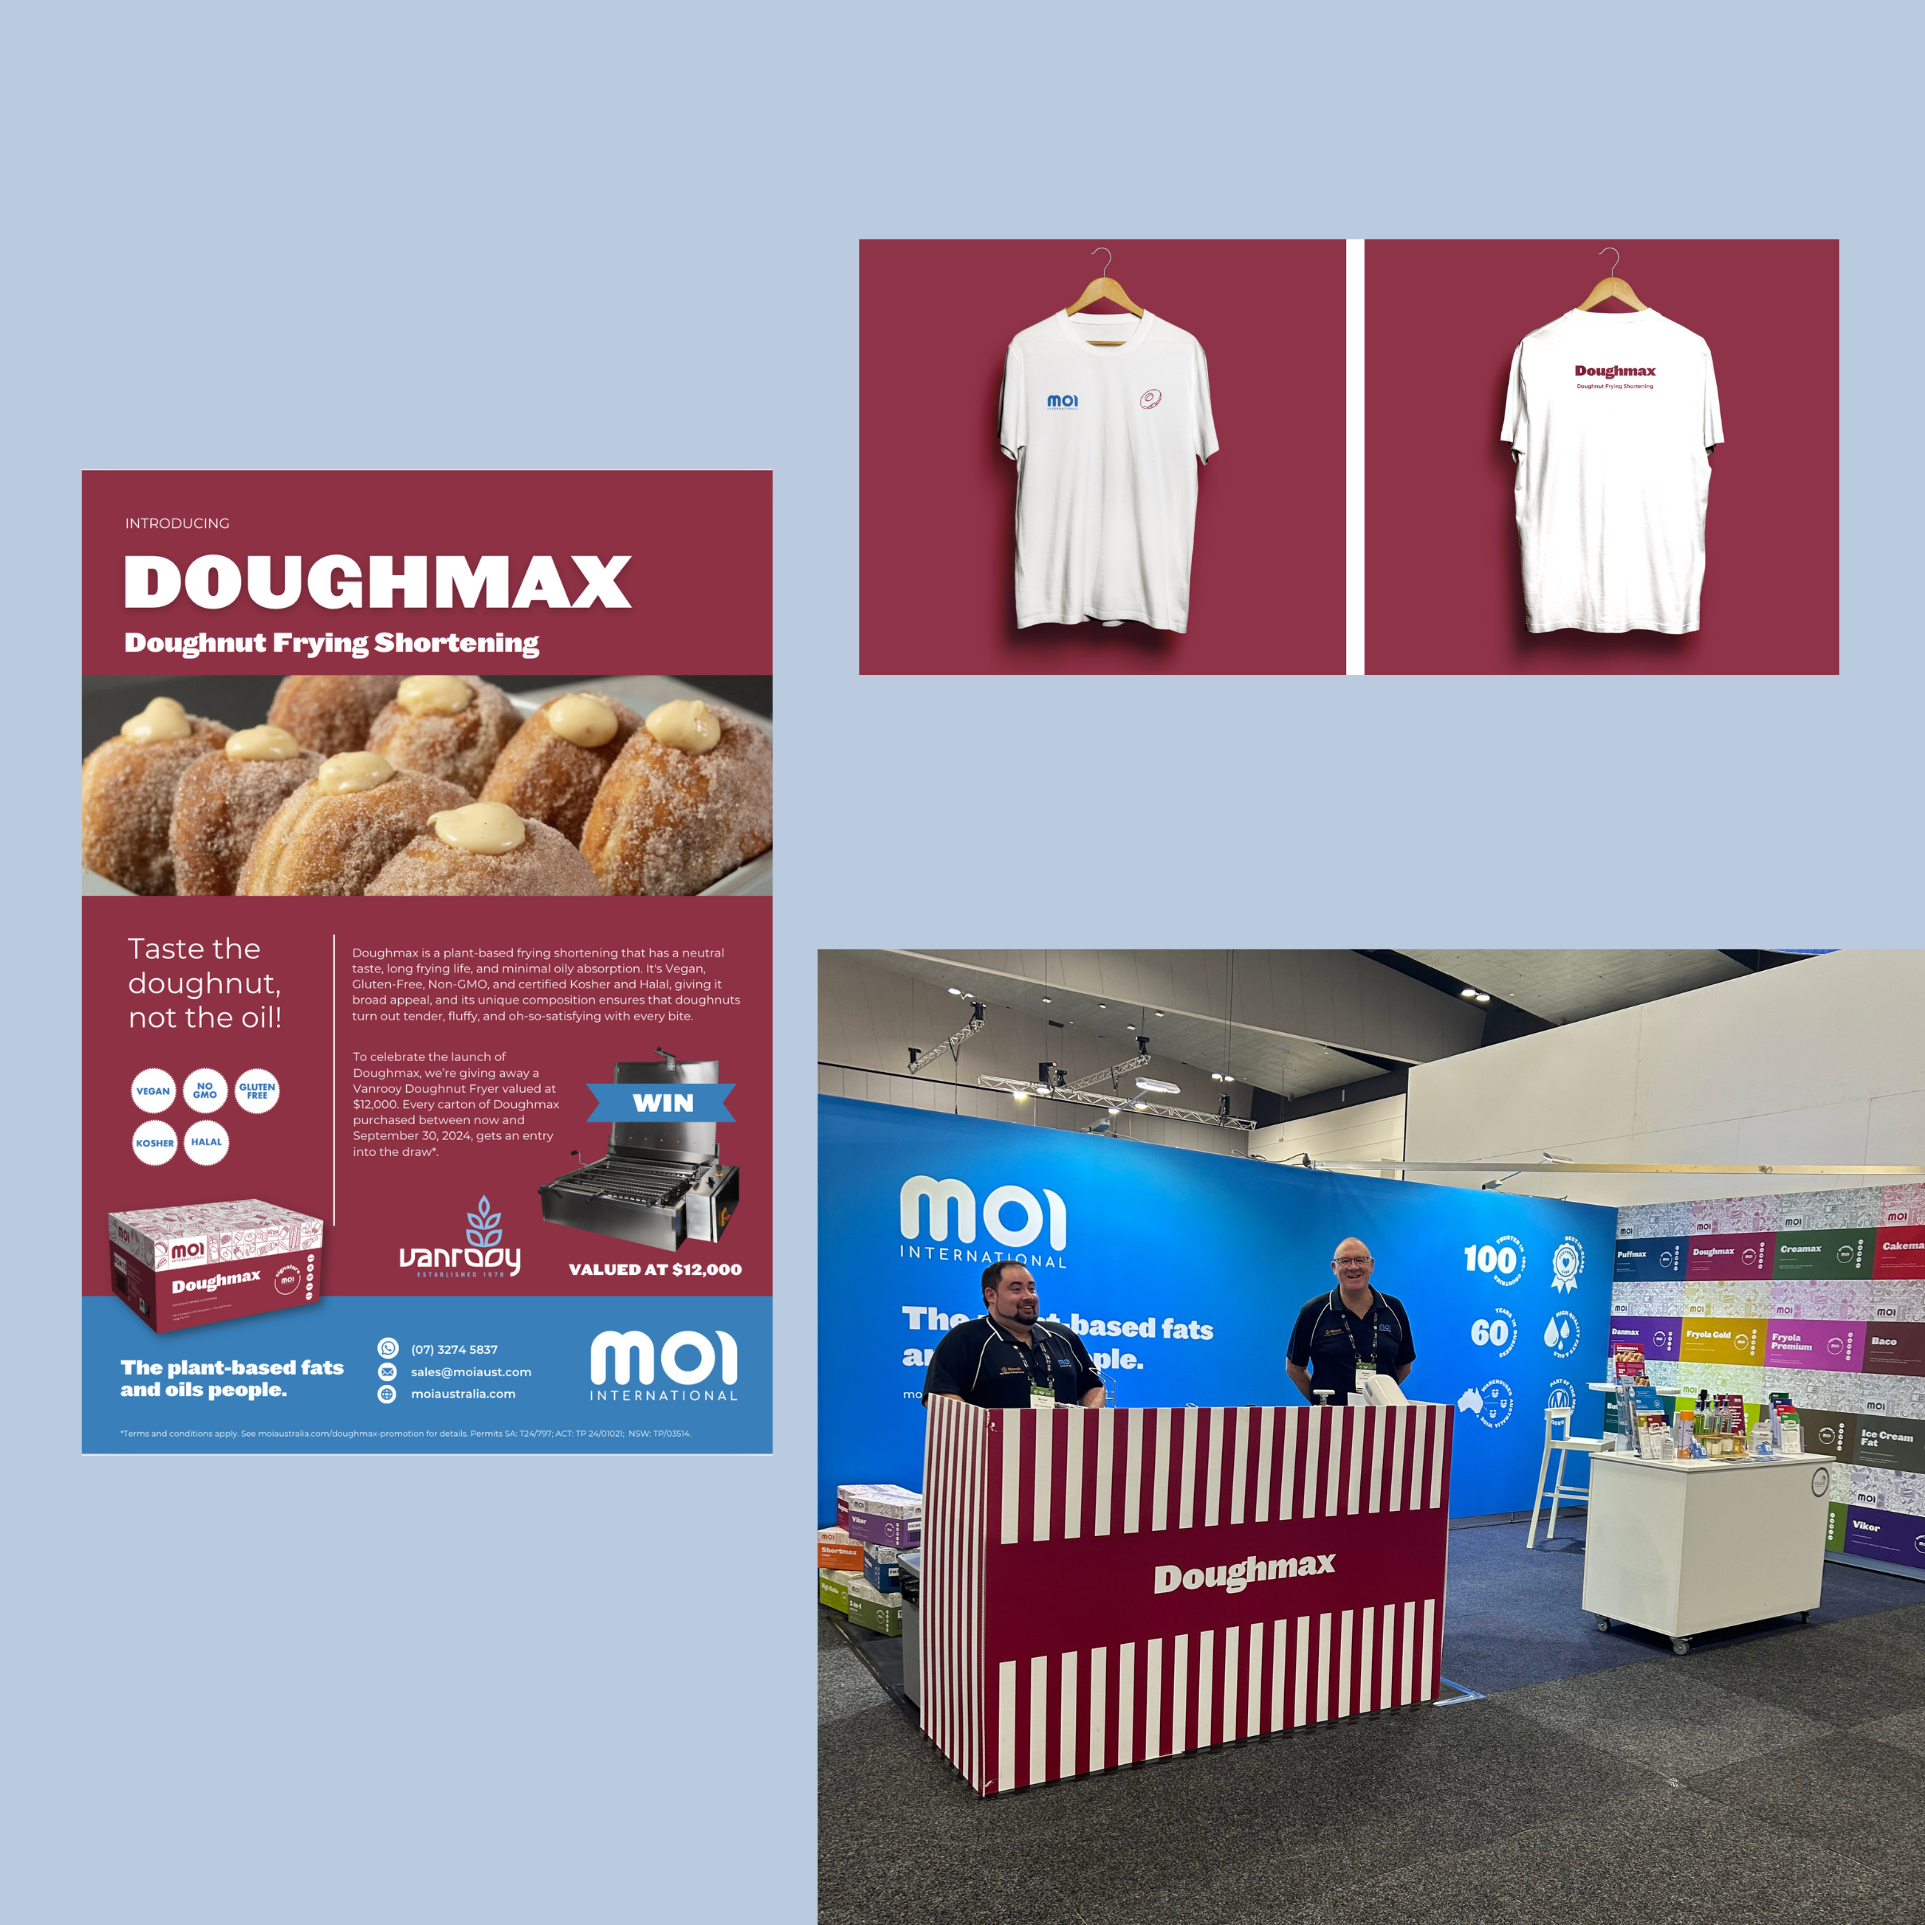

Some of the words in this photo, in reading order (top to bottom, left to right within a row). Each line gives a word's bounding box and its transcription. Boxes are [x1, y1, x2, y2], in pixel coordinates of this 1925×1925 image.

[1575, 365, 1656, 380] Doughmax
[126, 518, 229, 528] INTRODUCING
[125, 554, 632, 609] DOUGHMAX
[125, 633, 266, 659] Doughnut
[274, 633, 369, 659] Frying
[374, 632, 540, 659] Shortening
[128, 938, 204, 959] Taste
[213, 937, 260, 959] the
[353, 948, 418, 960] Doughmax
[422, 948, 430, 957] is
[444, 948, 513, 959] plant-based
[517, 948, 550, 960] frying
[554, 948, 618, 960] shortening
[621, 948, 645, 957] that
[649, 948, 669, 957] has
[683, 948, 724, 957] neutral
[129, 971, 280, 999] doughnut,
[130, 1008, 177, 1028] not
[185, 1006, 233, 1028] the
[242, 1006, 280, 1028] oil!
[353, 1052, 367, 1061] To
[370, 1052, 425, 1061] celebrate
[428, 1052, 448, 1061] the
[452, 1052, 491, 1061] launch
[495, 1052, 506, 1061] of
[136, 1087, 170, 1095] VEGAN
[197, 1082, 213, 1090] NO
[239, 1083, 275, 1091] GLUTEN
[193, 1091, 217, 1099] GMO
[633, 1094, 693, 1112] WIN
[354, 1115, 415, 1127] purchased
[419, 1115, 470, 1124] between
[503, 1115, 524, 1124] and
[191, 1138, 222, 1146] HALAL
[353, 1131, 419, 1142] September
[422, 1131, 439, 1142] 30,
[442, 1131, 473, 1141] 2024,
[476, 1132, 502, 1142] gets
[523, 1132, 553, 1142] entry
[136, 1139, 174, 1148] KOSHER
[354, 1147, 376, 1156] into
[380, 1147, 399, 1156] the
[1496, 1235, 1520, 1245] TRUSTED
[1882, 1241, 1925, 1251] Cakema
[1617, 1250, 1647, 1258] Puffmax
[1693, 1247, 1735, 1257] Doughmax
[1780, 1245, 1822, 1253] Creamax
[400, 1248, 520, 1277] vanrooy
[900, 1245, 1067, 1269] INTERNATIONAL
[1464, 1244, 1517, 1274] 100
[275, 1264, 301, 1278] signature
[569, 1264, 641, 1275] VALUED
[644, 1264, 668, 1275] AT
[672, 1263, 742, 1277] $12,000
[172, 1270, 261, 1294] Doughmax
[1494, 1273, 1522, 1287] COUNTRIES
[1495, 1307, 1512, 1319] YEARS
[902, 1305, 965, 1331] The
[1162, 1317, 1214, 1341] fats
[1555, 1310, 1569, 1318] HIGH
[1569, 1312, 1580, 1338] QUALITY
[1471, 1318, 1509, 1346] 60
[1611, 1328, 1639, 1336] Danmax
[1686, 1330, 1712, 1340] Fryola
[1713, 1331, 1732, 1339] Gold
[1772, 1333, 1801, 1343] Fryola
[1499, 1329, 1518, 1358] BUSINESS
[1771, 1341, 1813, 1351] Premium
[1871, 1336, 1898, 1346] Baco
[412, 1345, 433, 1356] (07)
[438, 1345, 466, 1354] 3274
[470, 1345, 498, 1354] 5837
[121, 1360, 163, 1375] The
[168, 1360, 296, 1379] plant-based
[301, 1360, 344, 1375] fats
[412, 1367, 531, 1379] sales@moiaust.com
[1481, 1379, 1512, 1396] WAREHOUSES
[1550, 1378, 1563, 1387] PART
[121, 1382, 160, 1396] and
[166, 1382, 203, 1396] oils
[209, 1382, 287, 1401] people.
[412, 1389, 515, 1398] moiaustralia.com
[591, 1391, 737, 1401] INTERNATIONAL
[1495, 1399, 1513, 1428] AUSTRALIA
[1480, 1416, 1493, 1428] WIDE
[215, 1430, 239, 1439] apply.
[258, 1430, 424, 1439] moiaustralia.com/doughmax-promotion
[520, 1430, 553, 1439] T24/797;
[588, 1430, 624, 1439] 24/01021;
[1861, 1429, 1878, 1438] Ice
[1879, 1430, 1914, 1443] Cream
[1861, 1438, 1879, 1447] Fat
[1853, 1520, 1881, 1532] Vikor
[821, 1546, 857, 1556] Shortmax
[1154, 1553, 1336, 1595] Doughmax
